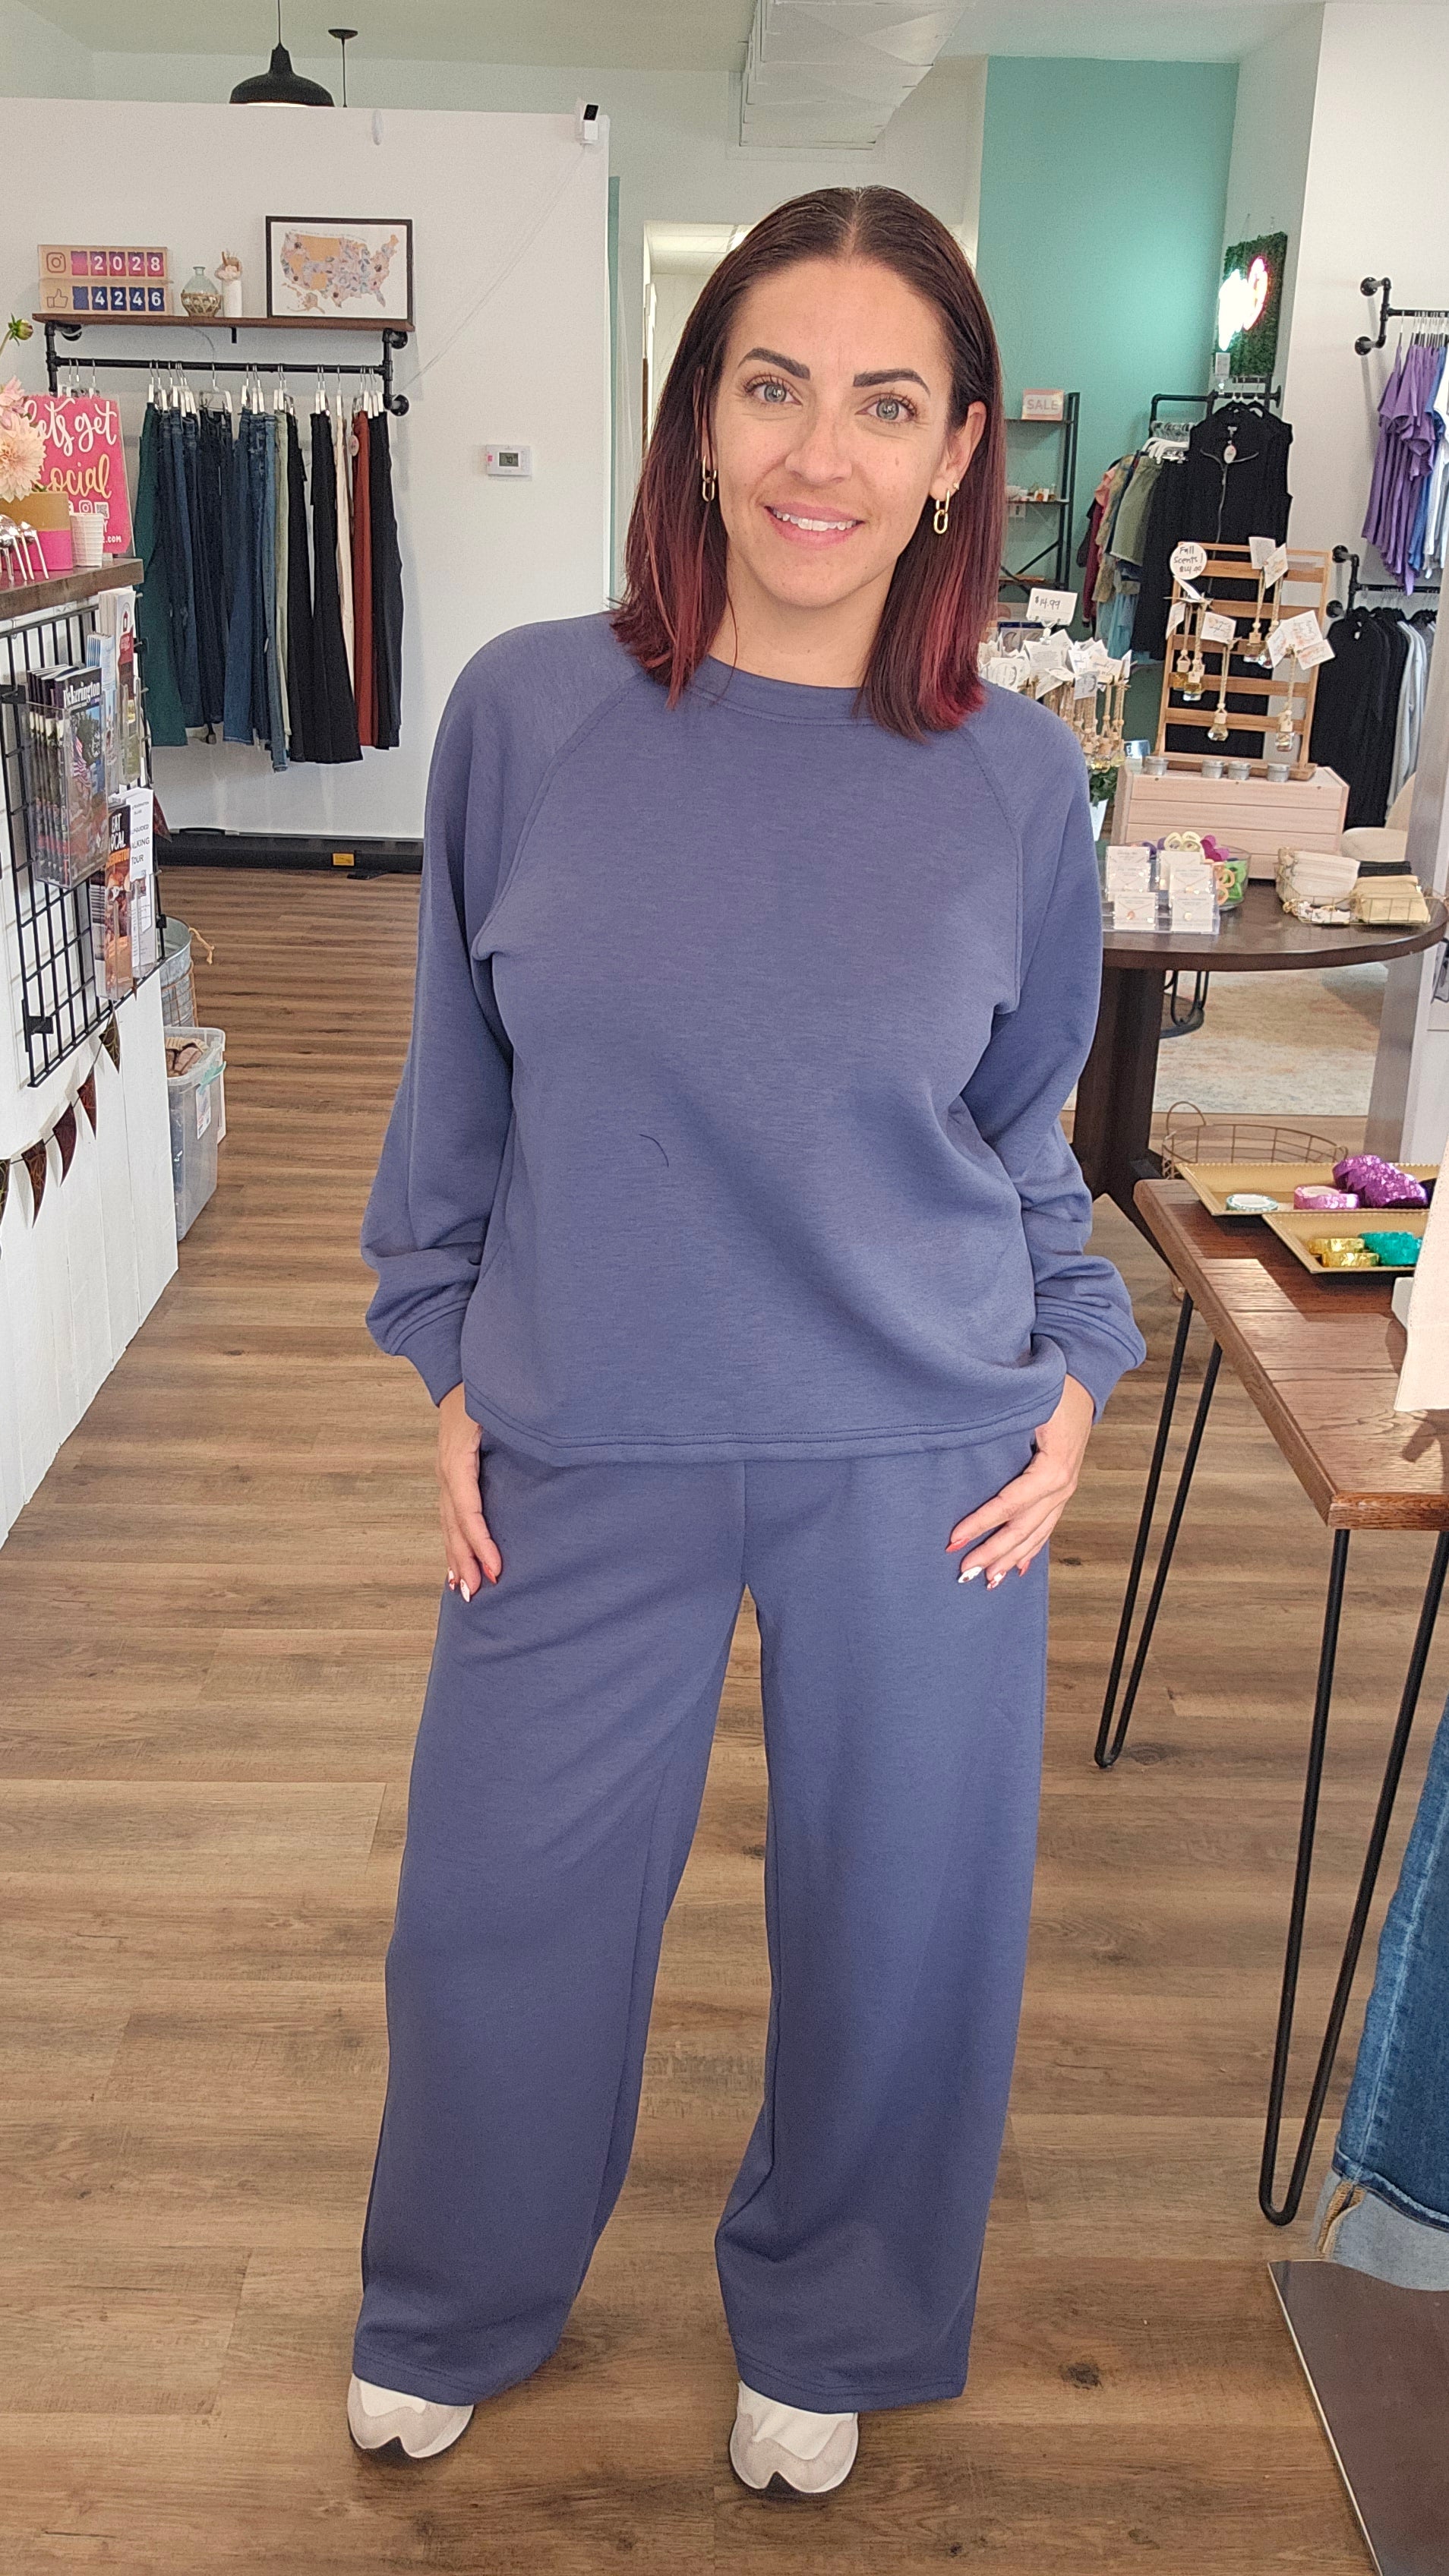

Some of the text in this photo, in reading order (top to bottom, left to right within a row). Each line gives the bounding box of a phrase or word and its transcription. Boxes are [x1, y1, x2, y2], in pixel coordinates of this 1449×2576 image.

[93, 255, 161, 272] 2028
[95, 290, 162, 306] 4246
[1027, 399, 1059, 411] SALE
[74, 400, 118, 453] get
[33, 454, 112, 500] ocial
[1179, 545, 1195, 555] Fall
[109, 830, 126, 852] OCAL
